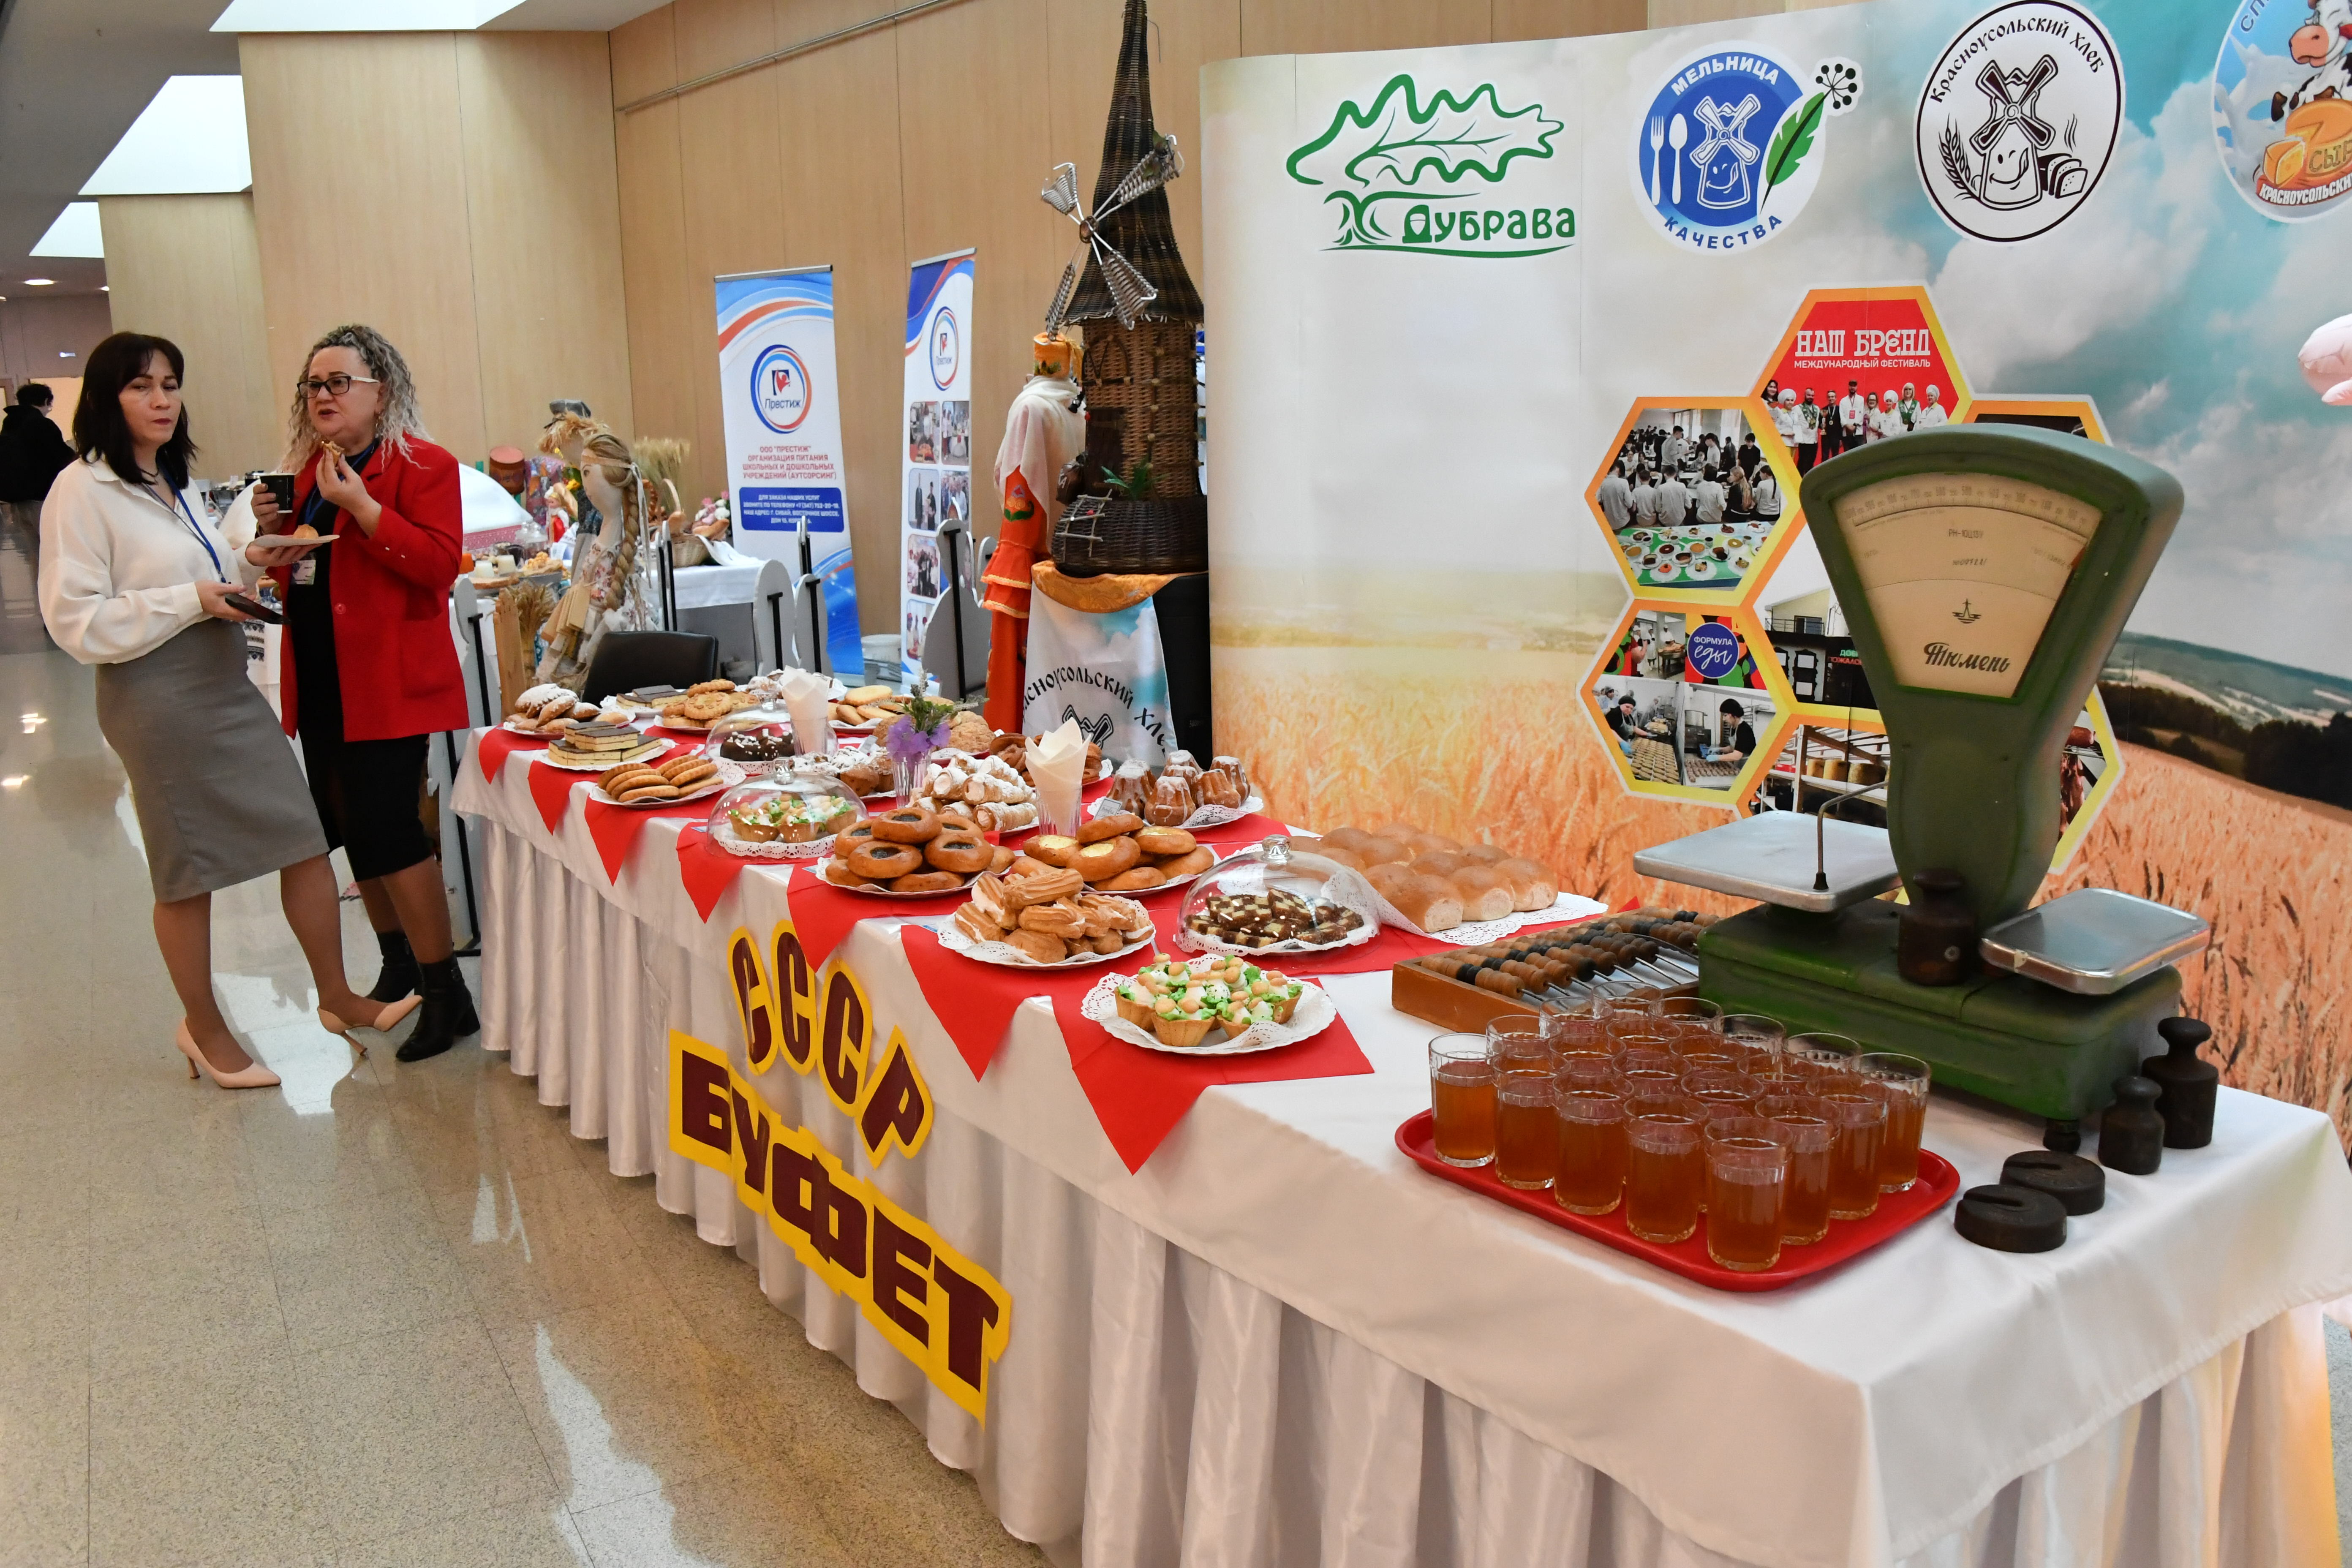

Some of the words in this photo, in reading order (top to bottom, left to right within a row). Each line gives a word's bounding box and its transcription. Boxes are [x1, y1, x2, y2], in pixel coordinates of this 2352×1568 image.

[2240, 0, 2270, 32] СП
[1671, 56, 1779, 95] МЕЛЬНИЦА
[1930, 18, 2069, 103] Красноусольский
[2259, 172, 2352, 205] КРАСНОУСОЛЬСКИ
[1402, 204, 1575, 244] Дубрава
[1664, 215, 1782, 249] КАЧЕСТВА
[1795, 330, 1845, 357] НАШ
[1854, 329, 1930, 356] БРЕНД
[1794, 358, 1879, 368] МЕЖДУНАРОДНЫЙ
[1881, 359, 1930, 368] ФЕСТИВАЛЬ
[765, 398, 801, 411] Престиж
[743, 471, 787, 479] УЧРЕЖДЕНИЙ
[788, 472, 837, 480] (АУТСОРСИНГ)
[1693, 636, 1733, 646] ФОРМУЛА
[1694, 645, 1733, 670] еды
[1923, 642, 2011, 673] Тюмень
[732, 931, 925, 1152] СССР
[682, 1049, 999, 1394] БУФЕТ
